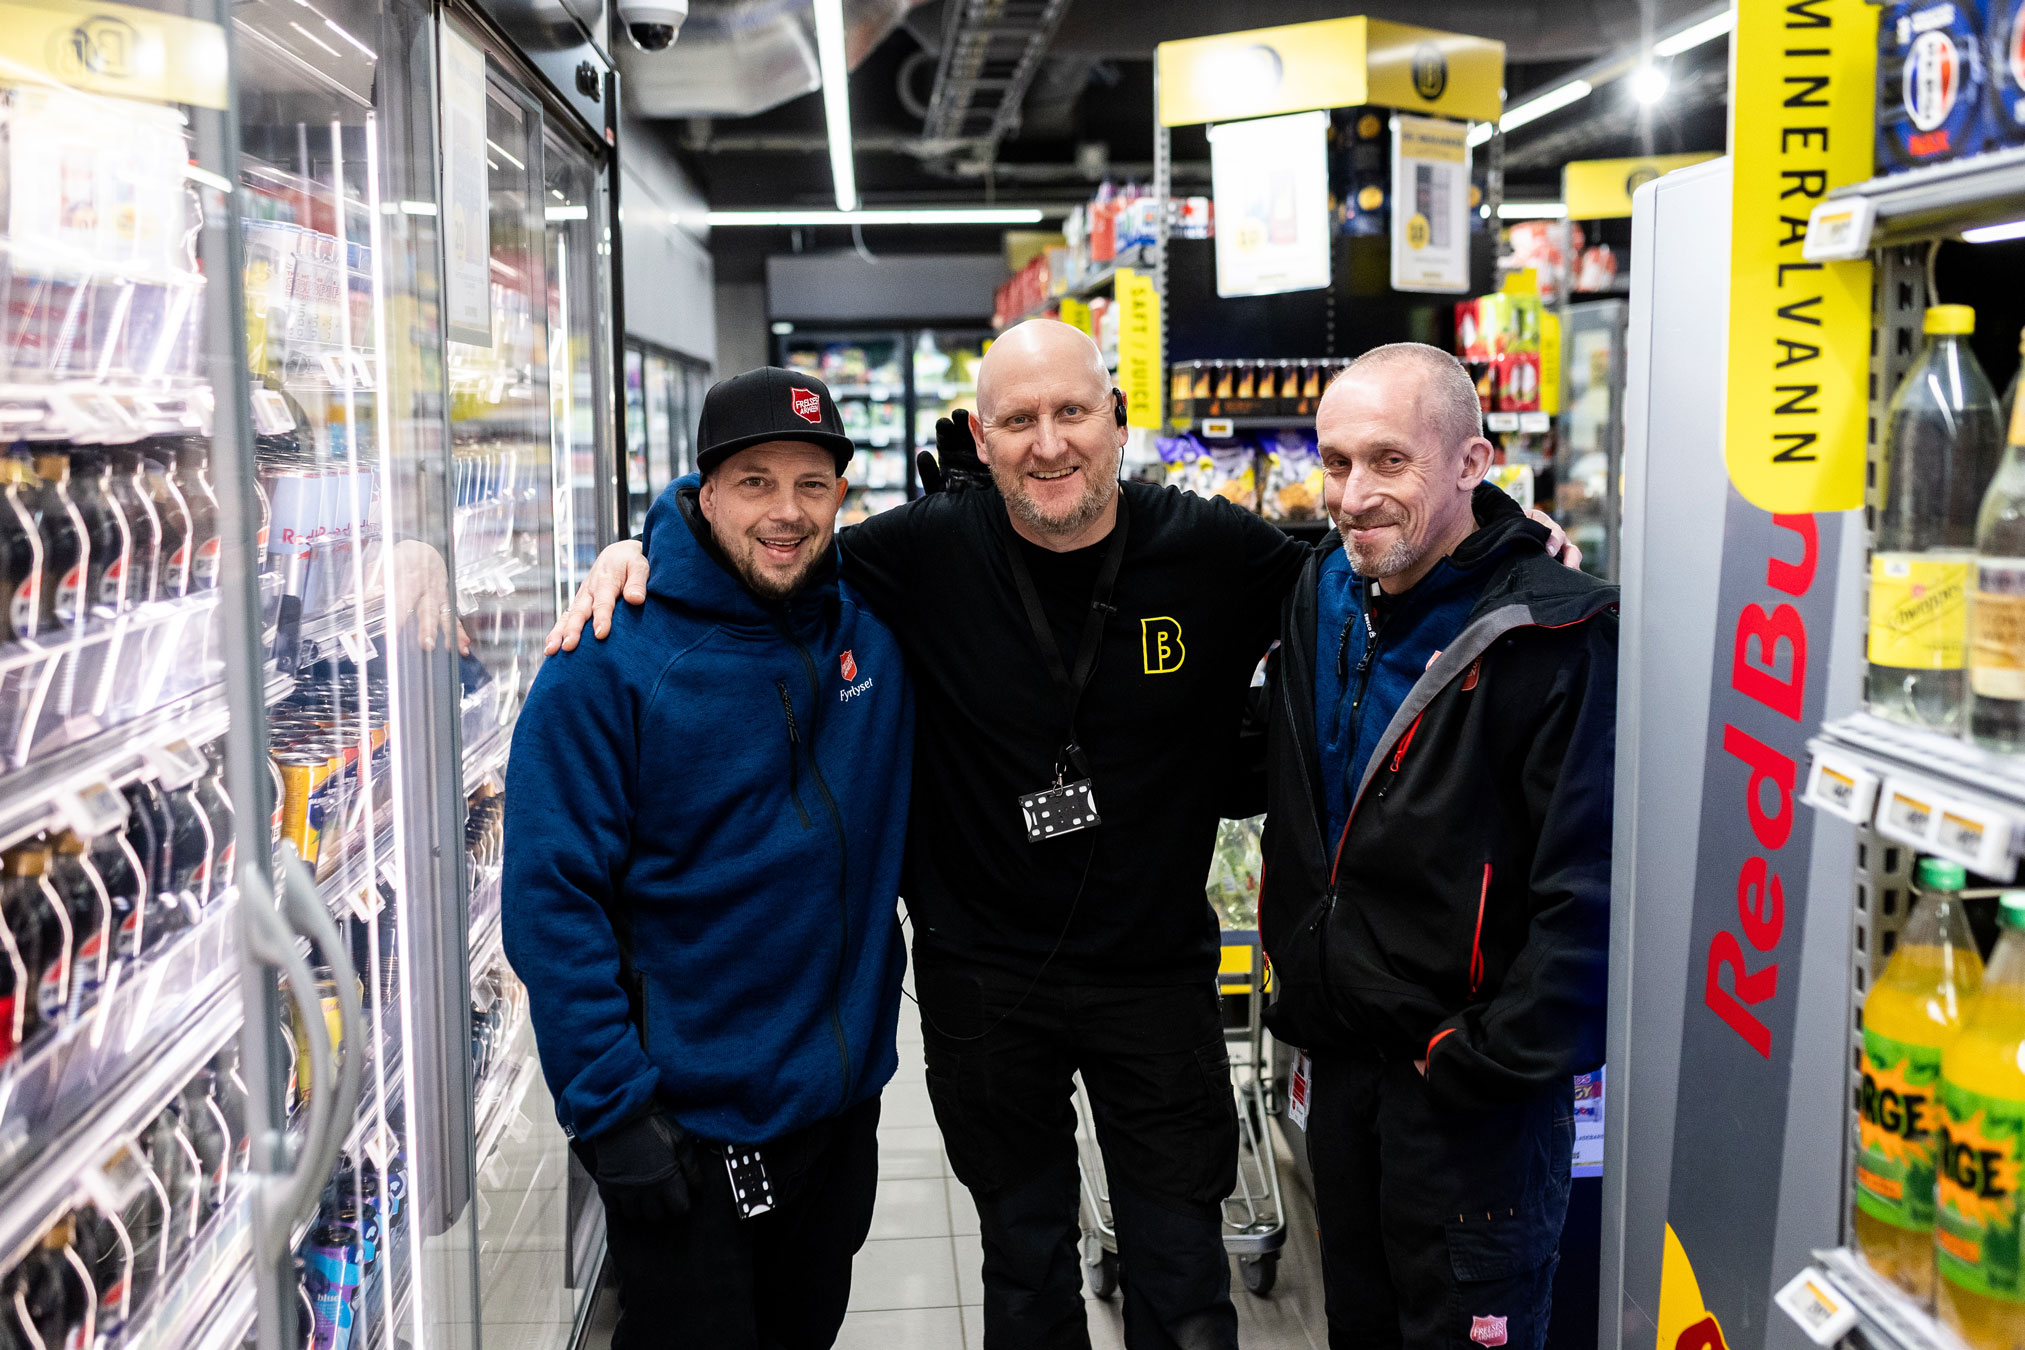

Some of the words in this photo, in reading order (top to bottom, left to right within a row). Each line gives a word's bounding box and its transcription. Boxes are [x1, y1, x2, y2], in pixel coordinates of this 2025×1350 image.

[1130, 286, 1147, 333] SAFT
[1131, 358, 1149, 412] JUICE
[839, 676, 874, 702] Fyrlyset
[1705, 723, 1797, 1060] Red
